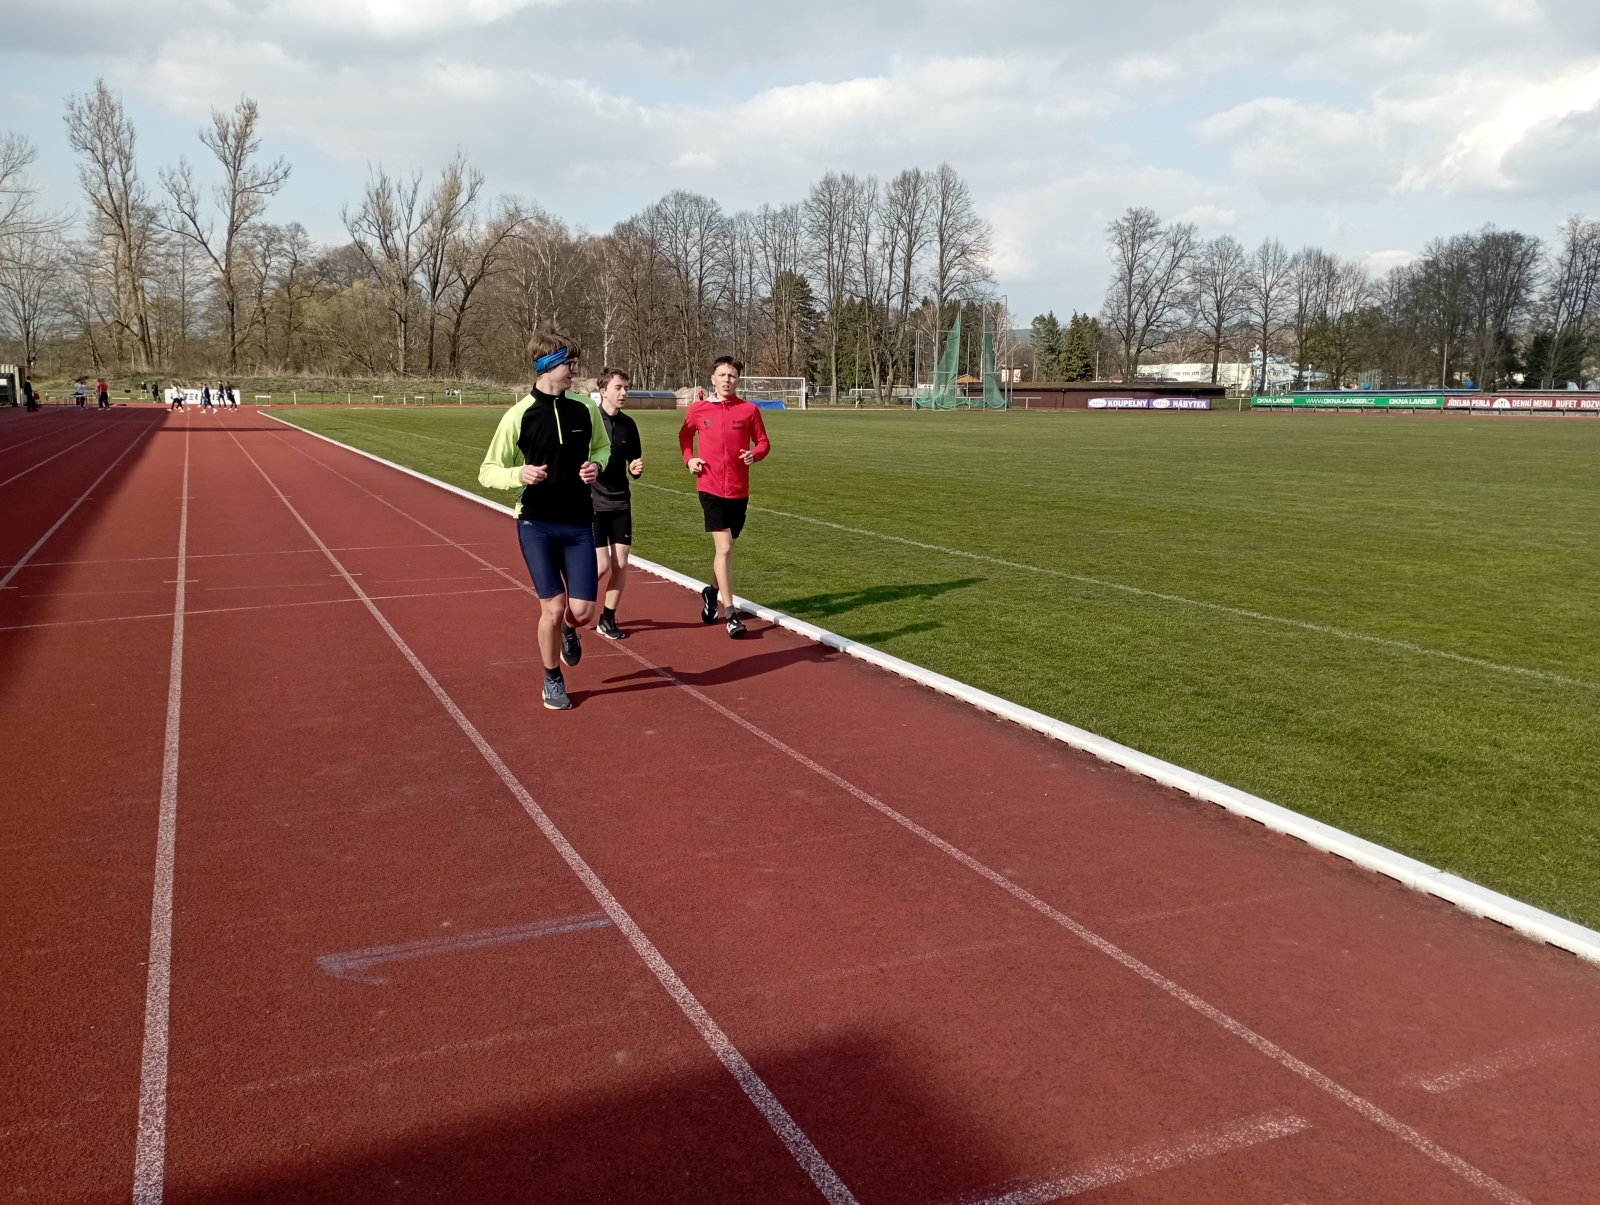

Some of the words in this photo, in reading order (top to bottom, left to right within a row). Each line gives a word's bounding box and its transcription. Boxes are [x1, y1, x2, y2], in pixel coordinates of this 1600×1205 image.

[1173, 399, 1206, 408] NÁBYTEK
[1447, 398, 1470, 406] JÍDELNA
[1512, 399, 1532, 407] DENNÍ
